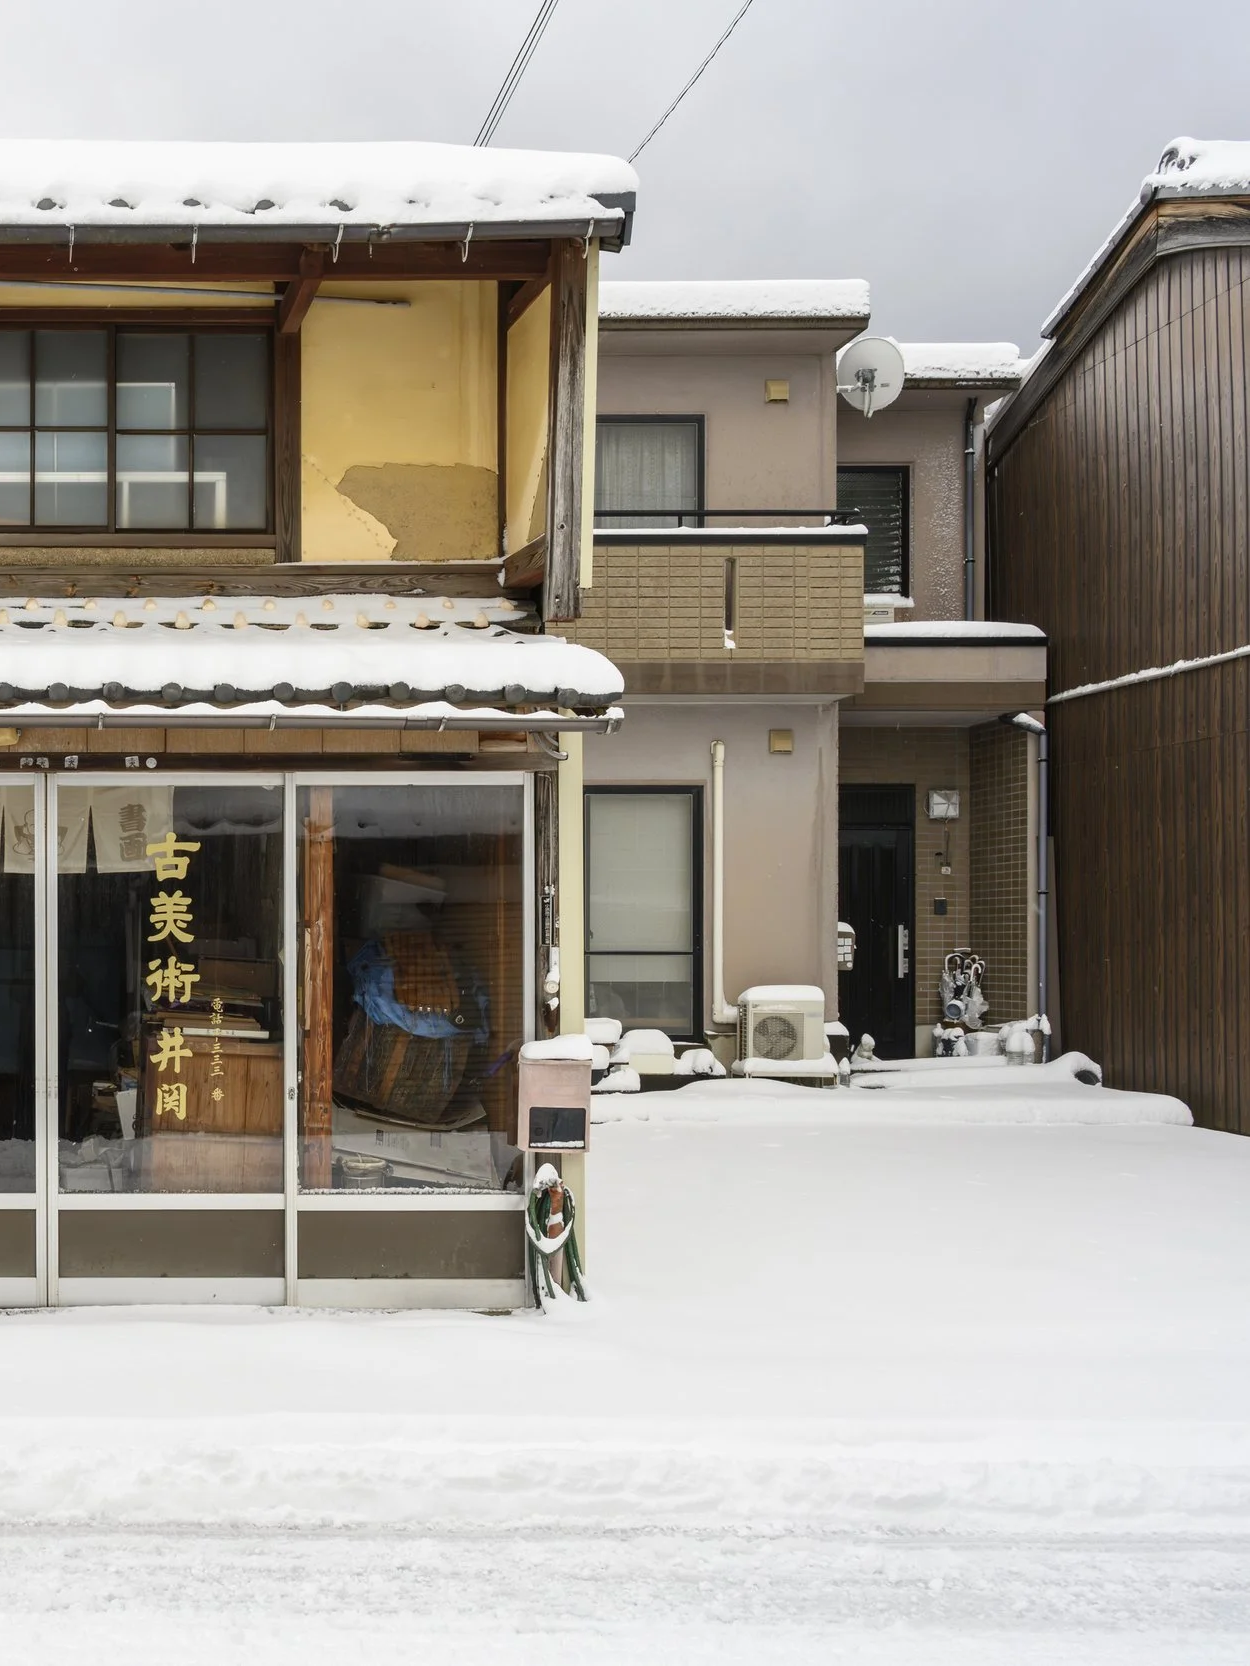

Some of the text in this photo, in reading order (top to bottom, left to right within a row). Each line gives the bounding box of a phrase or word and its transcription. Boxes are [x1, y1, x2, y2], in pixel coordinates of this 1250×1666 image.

[119, 803, 148, 862] 書画
[146, 832, 201, 1004] 古美術
